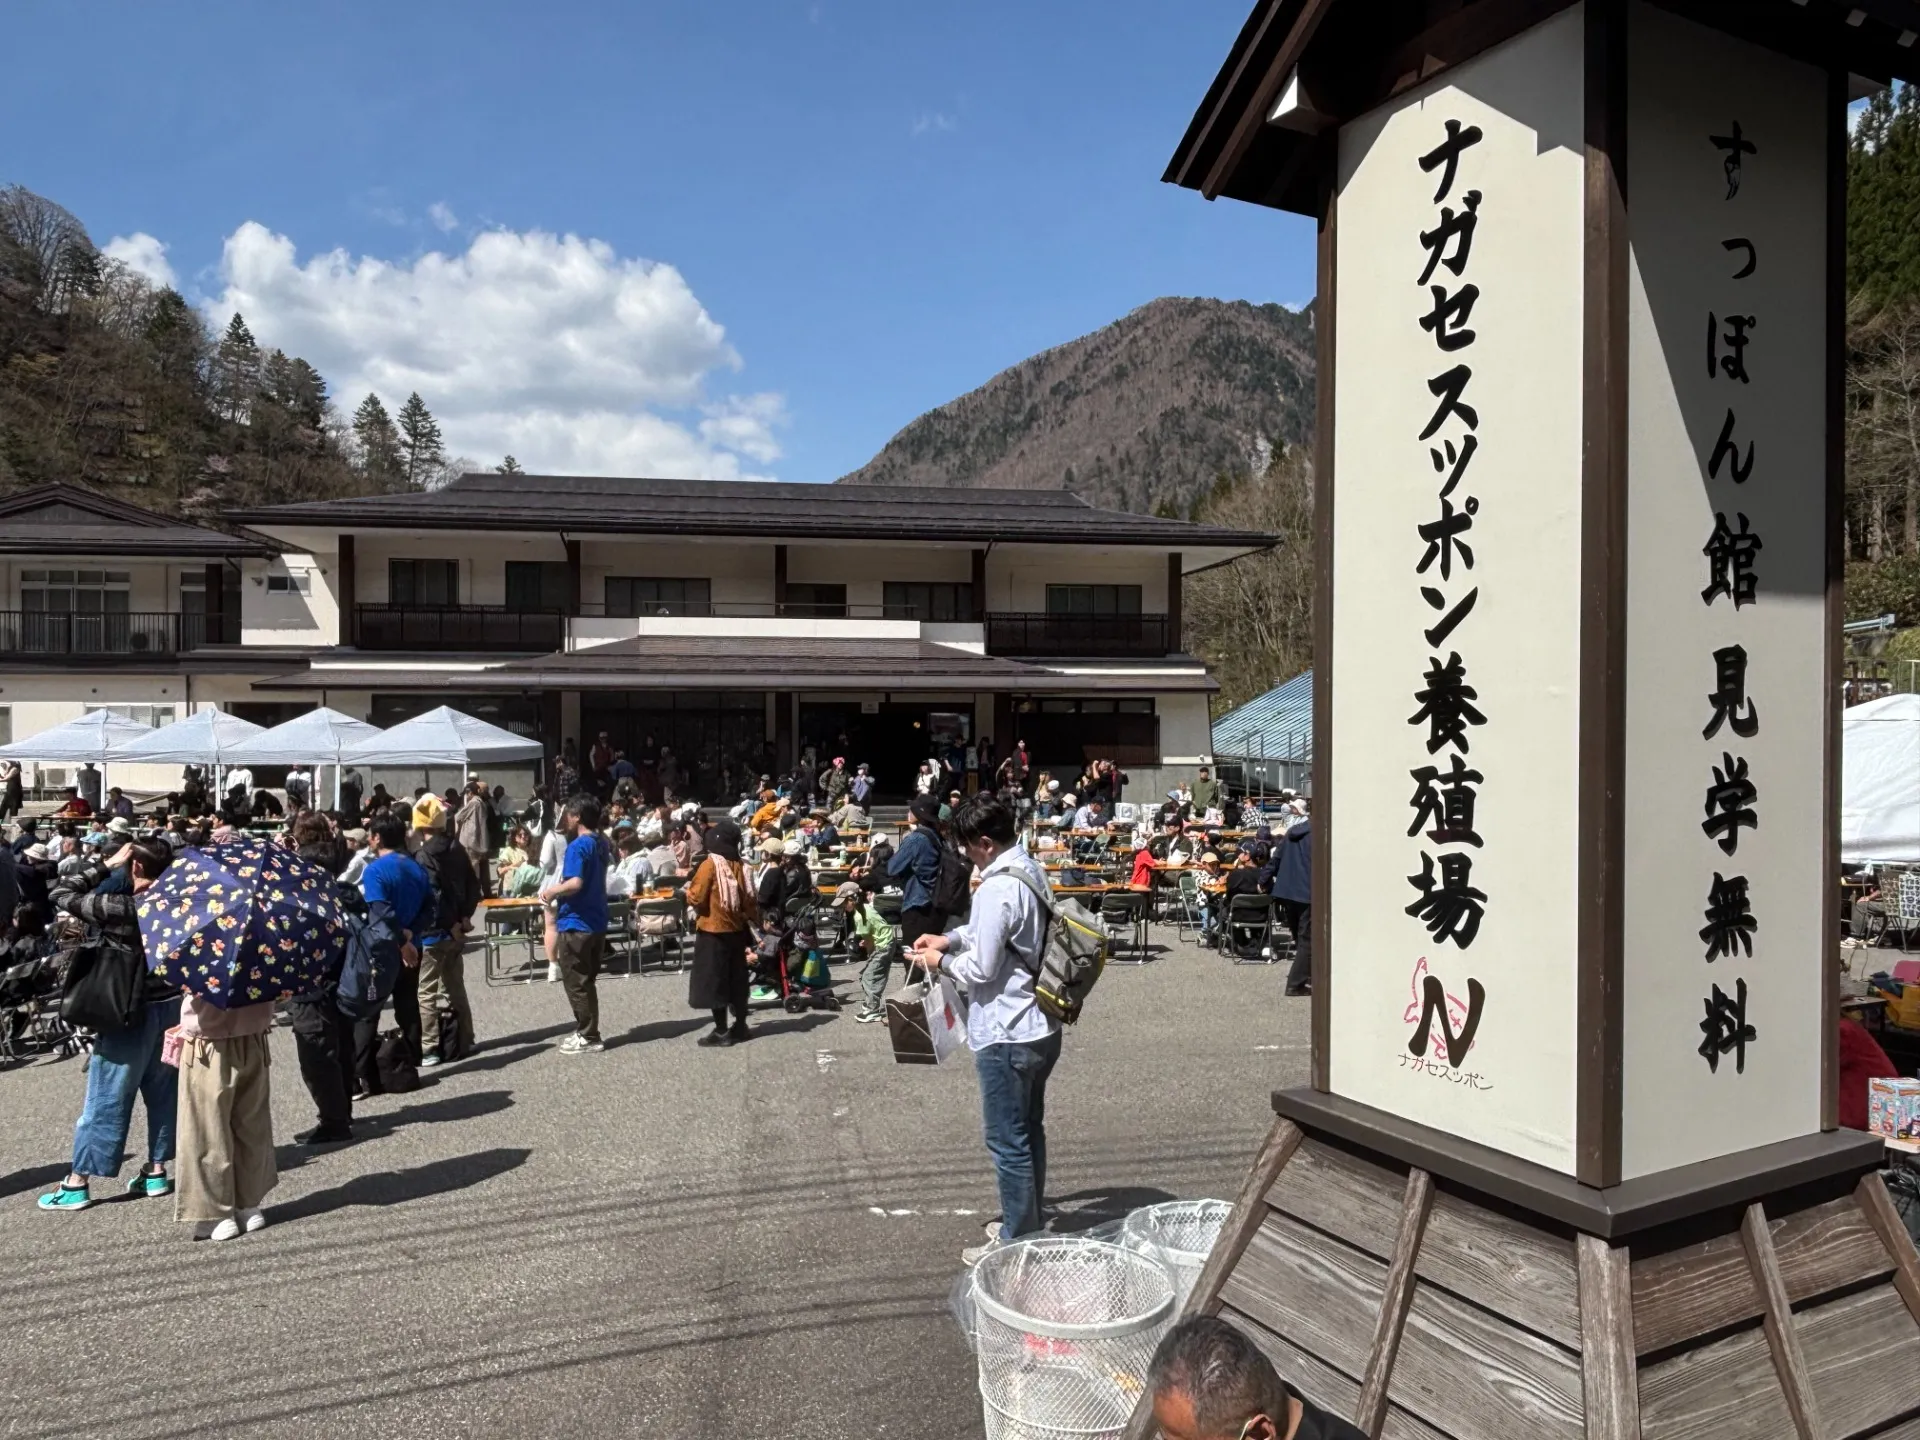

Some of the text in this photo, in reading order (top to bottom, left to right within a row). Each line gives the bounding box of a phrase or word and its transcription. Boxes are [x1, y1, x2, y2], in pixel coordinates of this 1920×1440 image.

[1405, 119, 1488, 949] ナガセスッポン養殖場
[1398, 1053, 1493, 1090] ナガセスッポン
